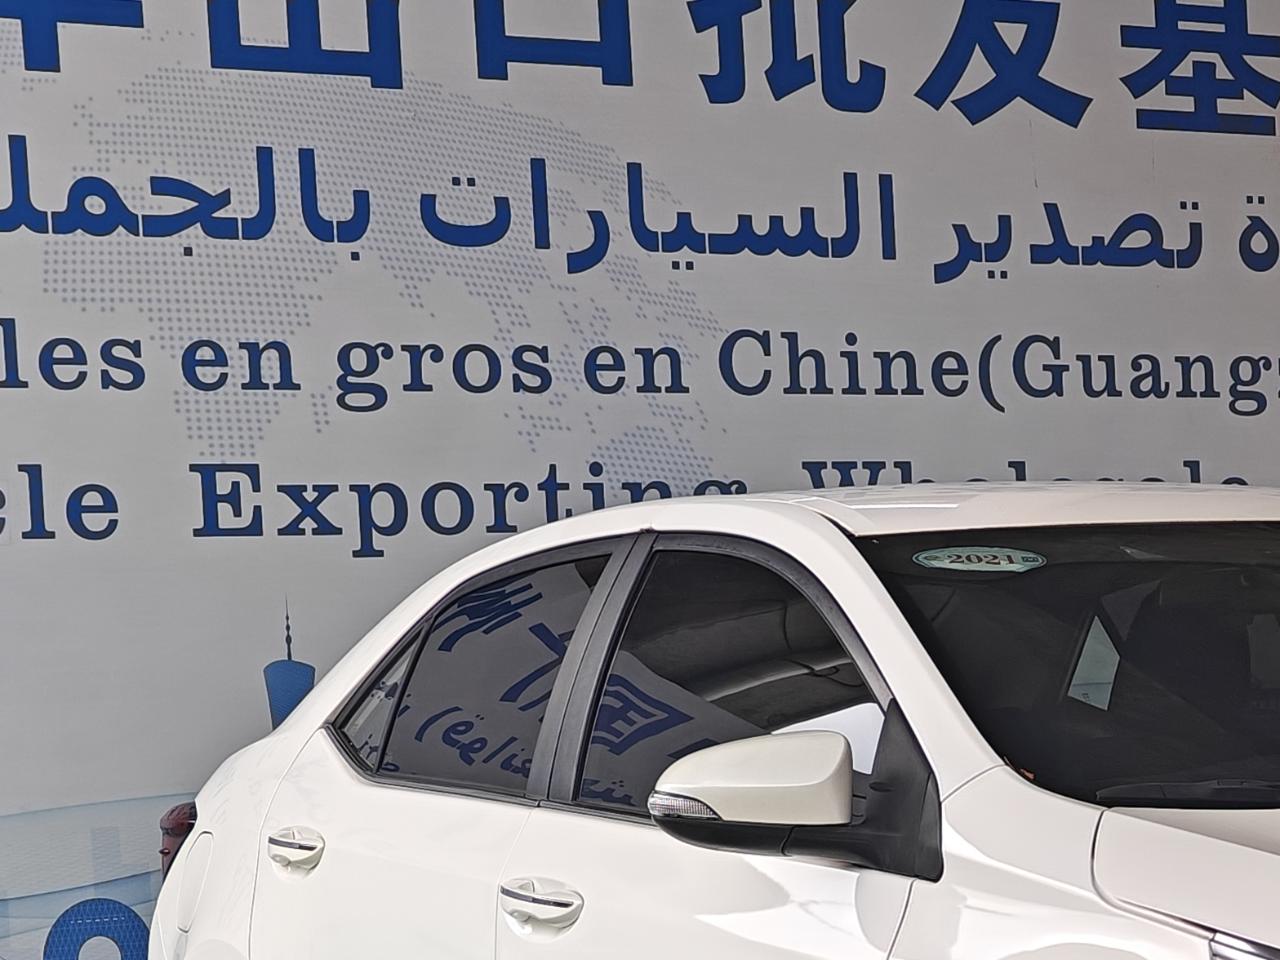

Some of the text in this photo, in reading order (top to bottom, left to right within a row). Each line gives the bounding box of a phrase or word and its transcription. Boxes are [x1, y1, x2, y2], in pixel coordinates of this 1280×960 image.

[0, 133, 371, 262] بالجمل
[419, 157, 898, 274] السيارات
[933, 200, 1203, 285] تصدير
[180, 336, 301, 392] en
[335, 340, 554, 413] gros
[583, 344, 690, 395] en
[0, 463, 119, 541] le
